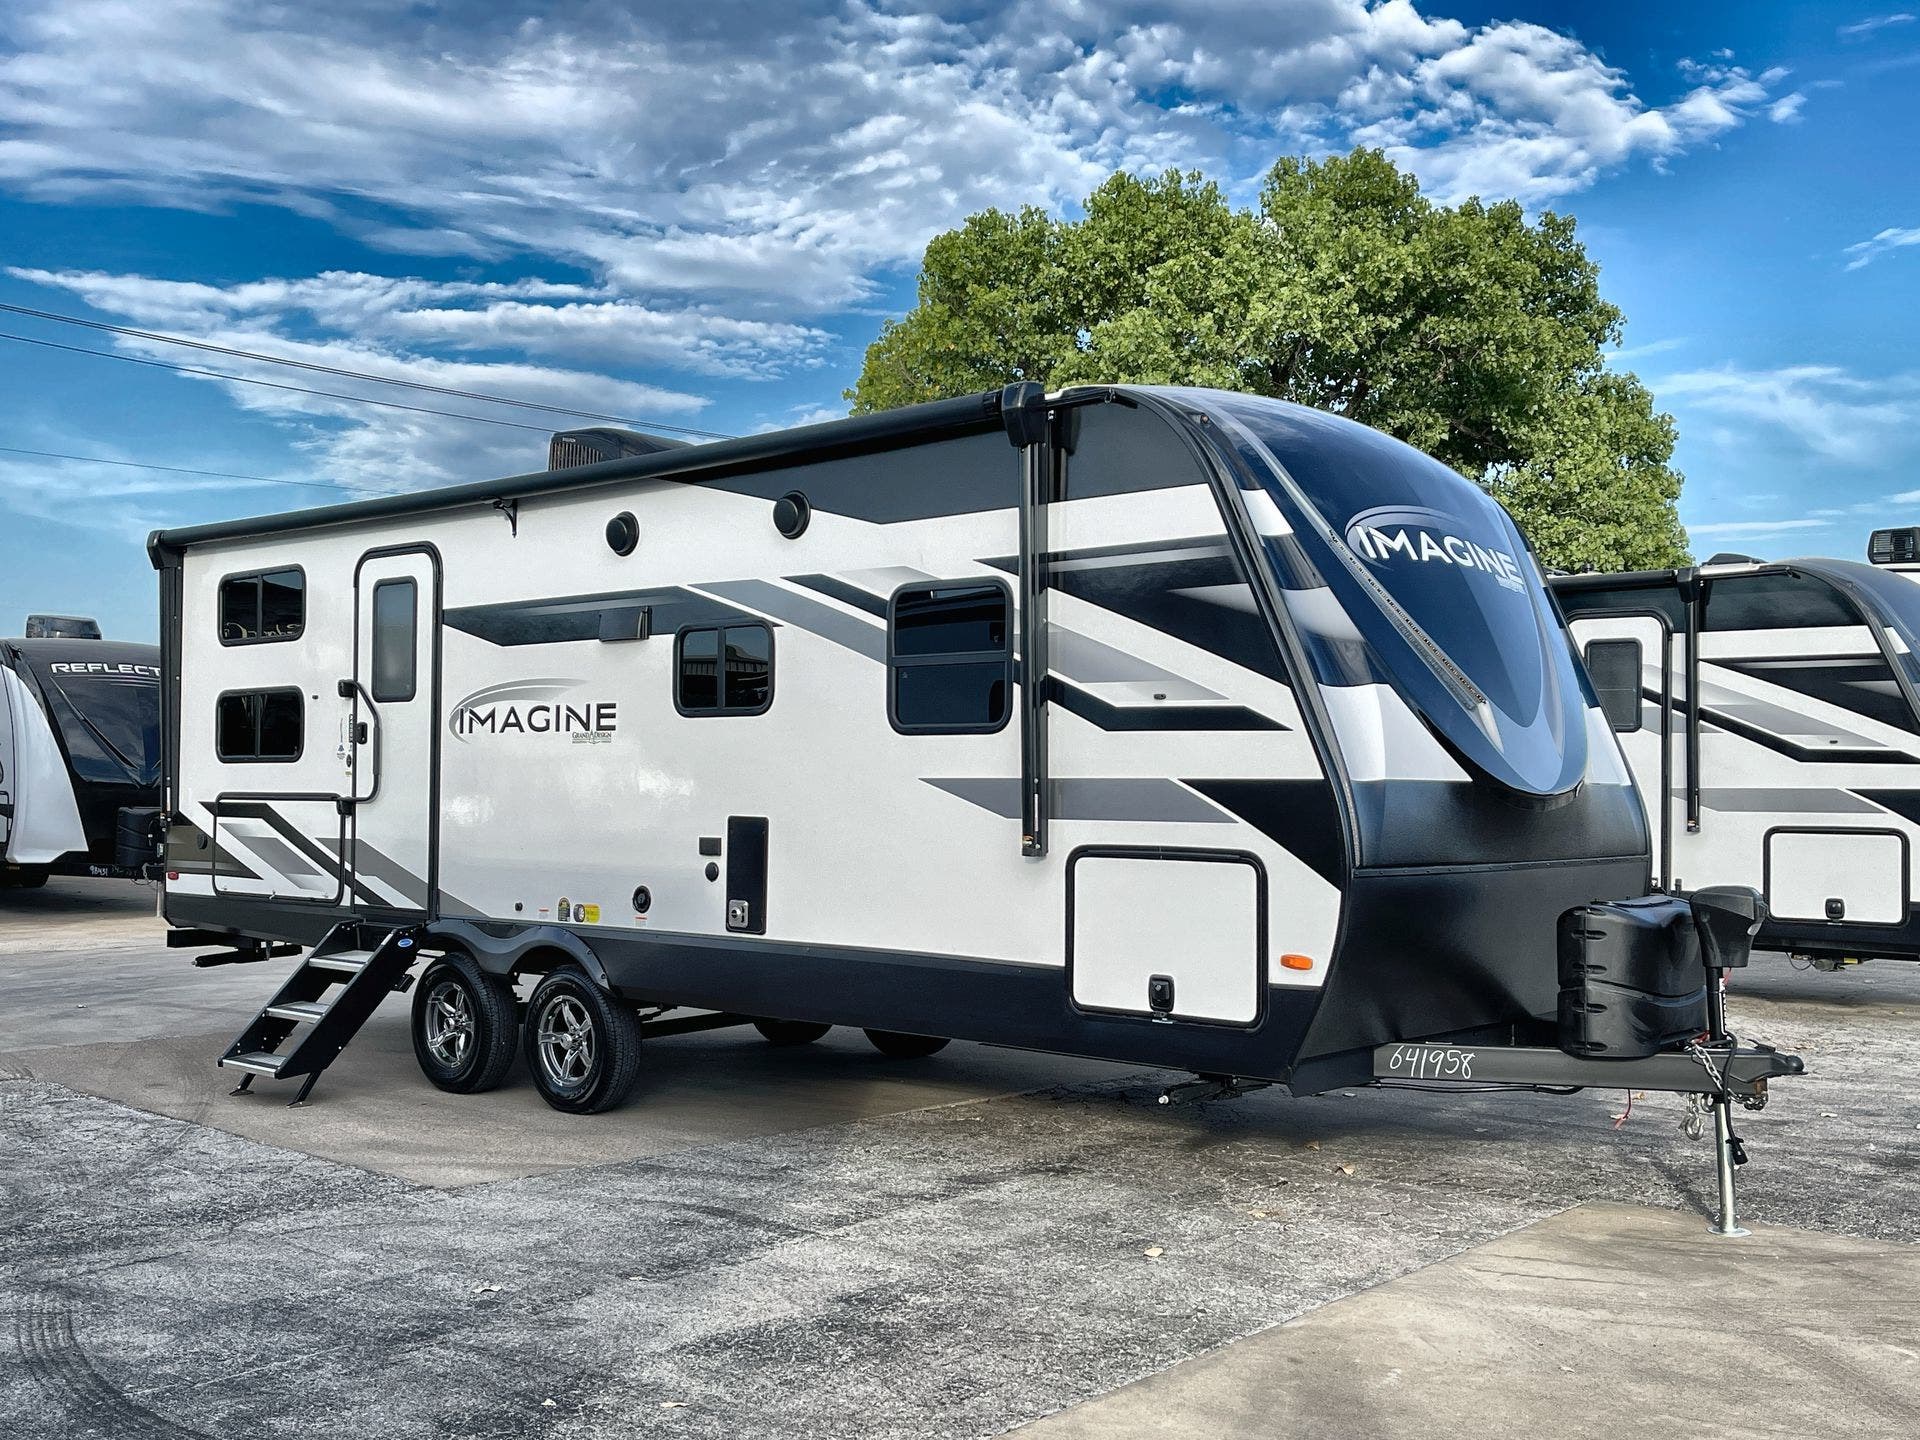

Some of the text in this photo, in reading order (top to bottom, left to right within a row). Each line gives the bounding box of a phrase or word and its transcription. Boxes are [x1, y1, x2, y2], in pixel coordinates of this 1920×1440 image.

[1355, 525, 1524, 584] IMAGINE
[459, 703, 617, 734] IMAGINE
[1390, 1045, 1475, 1079] 641958
